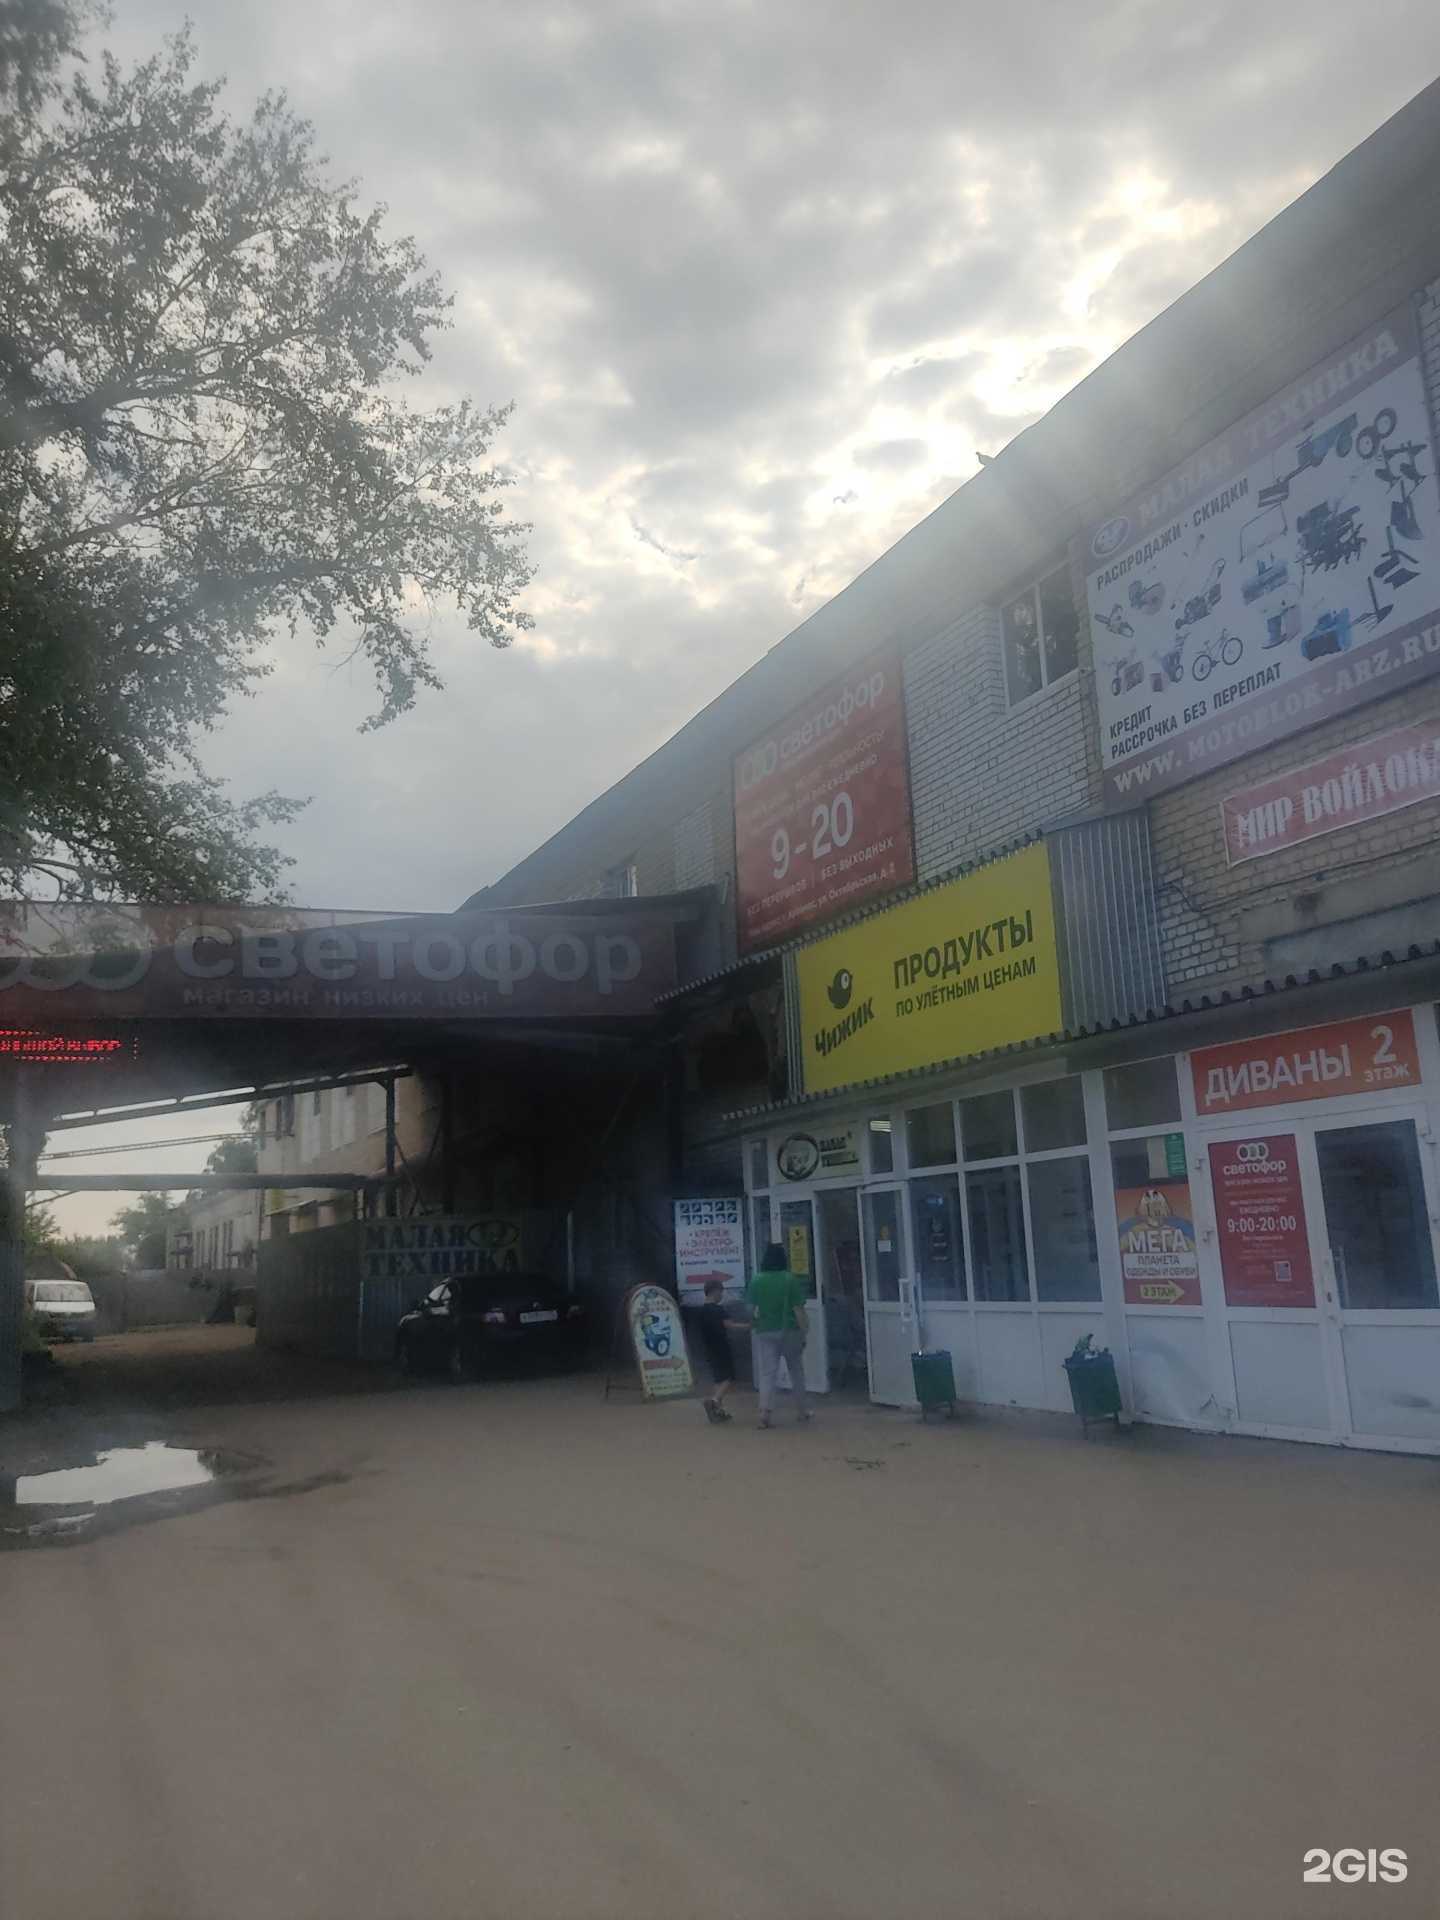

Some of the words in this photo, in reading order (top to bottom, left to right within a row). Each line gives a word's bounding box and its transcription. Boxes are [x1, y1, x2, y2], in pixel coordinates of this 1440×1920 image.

[1138, 441, 1233, 529] МАЛАЯ
[1247, 330, 1400, 448] ТЕХНИКА
[1097, 523, 1181, 591] РАСПРОДАЖИ
[1193, 478, 1249, 527] СКИДКИ
[780, 671, 885, 760] светофор
[1110, 704, 1153, 739] КРЕДИТ
[1111, 714, 1178, 759] РАССРОЧКА
[1184, 698, 1208, 724] БЕЗ
[1214, 661, 1282, 711] ПЕРЕПЛАТ
[1237, 796, 1293, 849] МИР
[1302, 736, 1440, 825] ВОЙЛОК
[771, 791, 854, 880] 9-20
[175, 920, 643, 994] светофор
[893, 909, 1034, 990] ПРОДУКТЫ
[183, 986, 309, 1007] магазин
[324, 989, 424, 1006] низких
[438, 989, 489, 1008] цен
[896, 1000, 914, 1018] ПО
[915, 975, 980, 1011] УЛЁТНЫМ
[983, 956, 1037, 992] ЦЕНАМ
[1205, 1042, 1352, 1106] ДИВАНЫ
[1364, 1061, 1411, 1084] этаж
[1371, 1025, 1397, 1065] 2
[1223, 1159, 1287, 1176] светофор
[1128, 1228, 1189, 1253] МЕГА
[1227, 1215, 1297, 1233] 9:00-20:00
